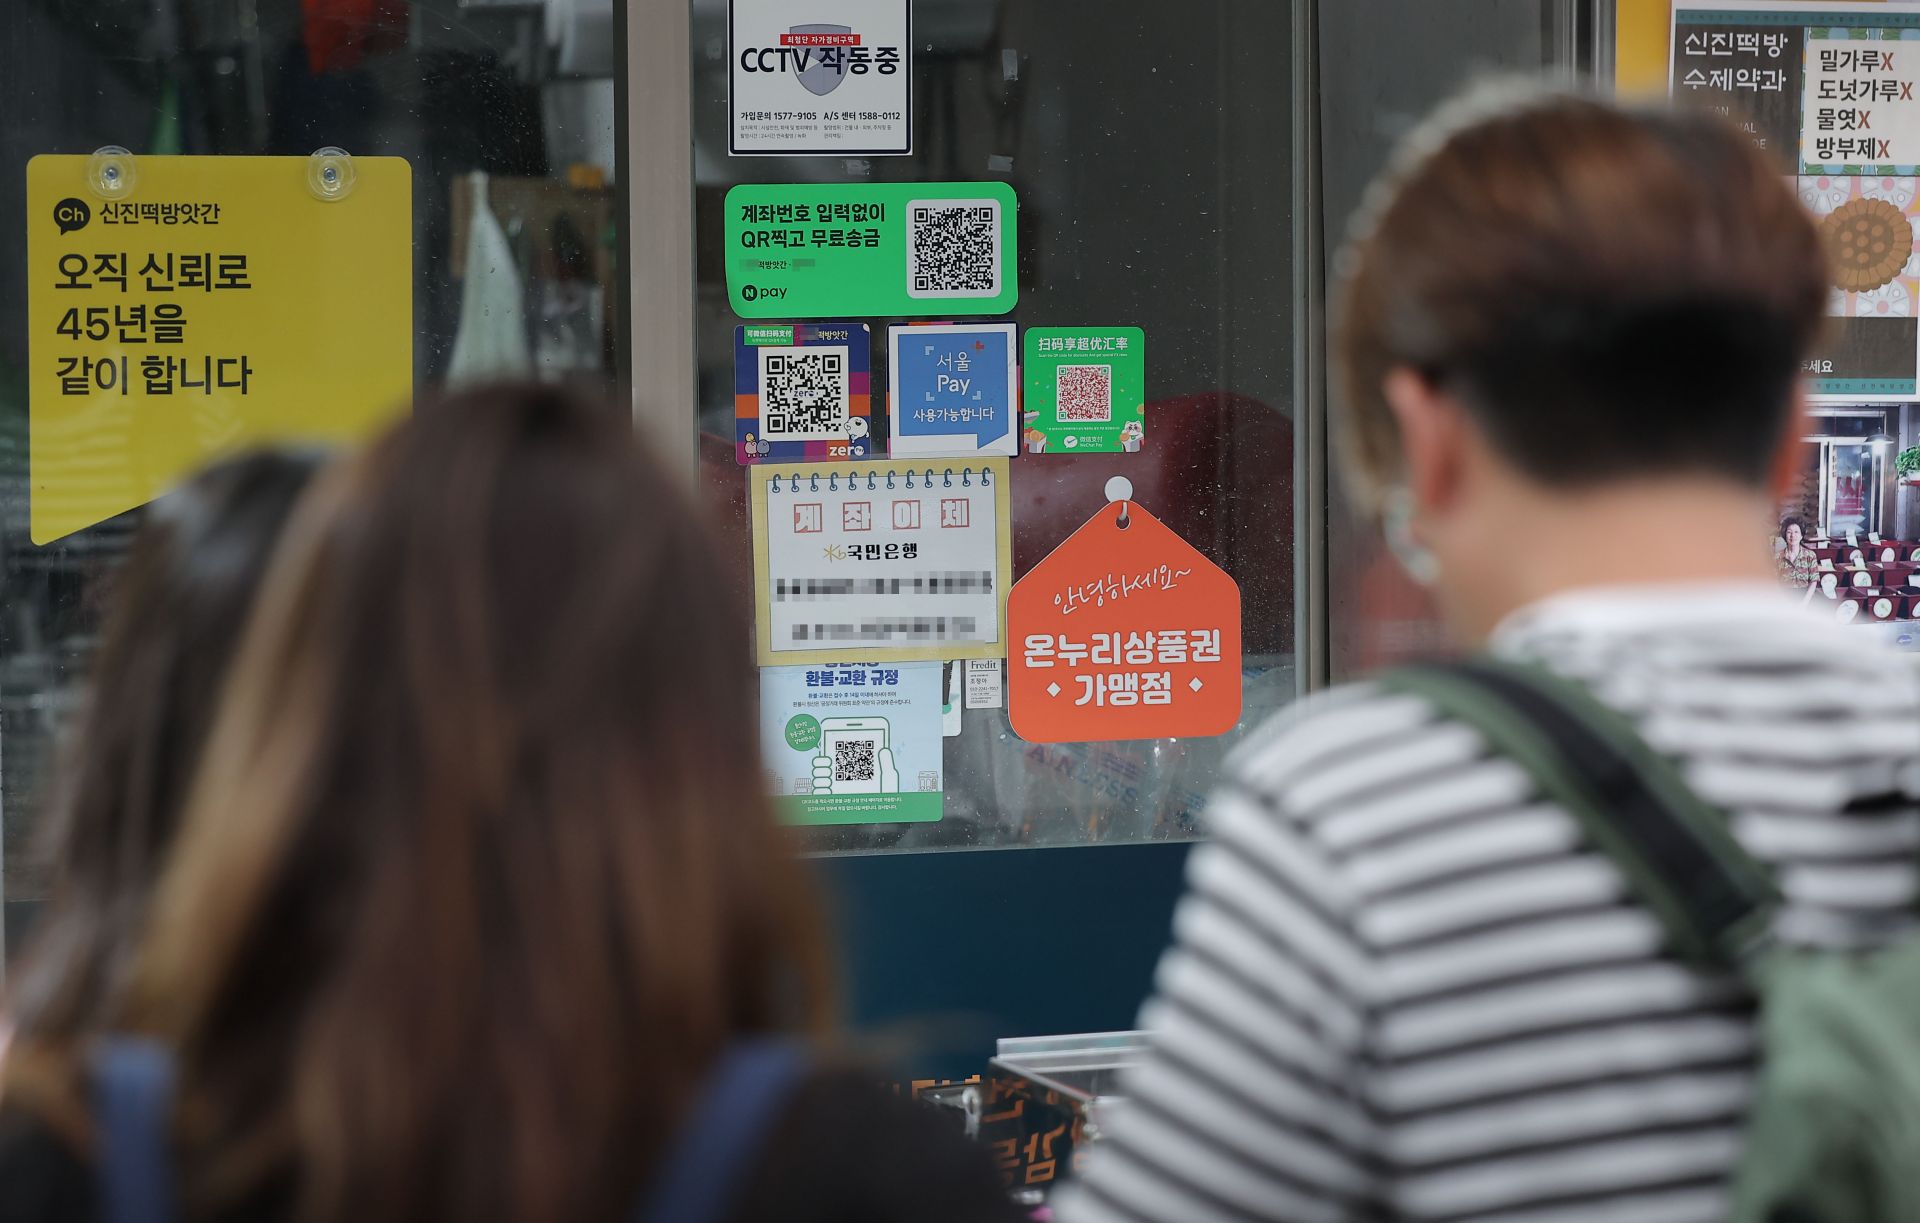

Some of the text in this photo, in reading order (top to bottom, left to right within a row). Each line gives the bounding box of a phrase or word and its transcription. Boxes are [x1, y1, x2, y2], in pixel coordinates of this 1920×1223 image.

[740, 47, 900, 75] CCTV 작동중
[1819, 49, 1894, 73] 밀가루X
[740, 111, 817, 121] 가입문의 1577-9105
[823, 111, 901, 121] A/S 센터 1588-0112
[1816, 108, 1871, 131] 물엿X
[1815, 137, 1892, 161] 방부제X
[58, 203, 221, 225] Ch 신진떡방앗간
[741, 203, 885, 224] 계좌번호 입력없이
[741, 228, 881, 249] QR찍고 무료송금
[54, 252, 252, 293] 오직 신뢰로
[55, 303, 188, 344] 45년을
[1038, 336, 1128, 351] 扫码享超优汇率
[936, 351, 972, 372] 서울
[54, 355, 253, 396] 같이 합니다
[937, 374, 971, 396] Pay
[913, 406, 995, 423] 사용가능합니다
[847, 543, 918, 561] 국민은행
[1023, 628, 1222, 668] 온누리상품권
[971, 659, 997, 669] Fredit
[870, 669, 899, 686] 규정
[1074, 671, 1173, 707] 가맹점
